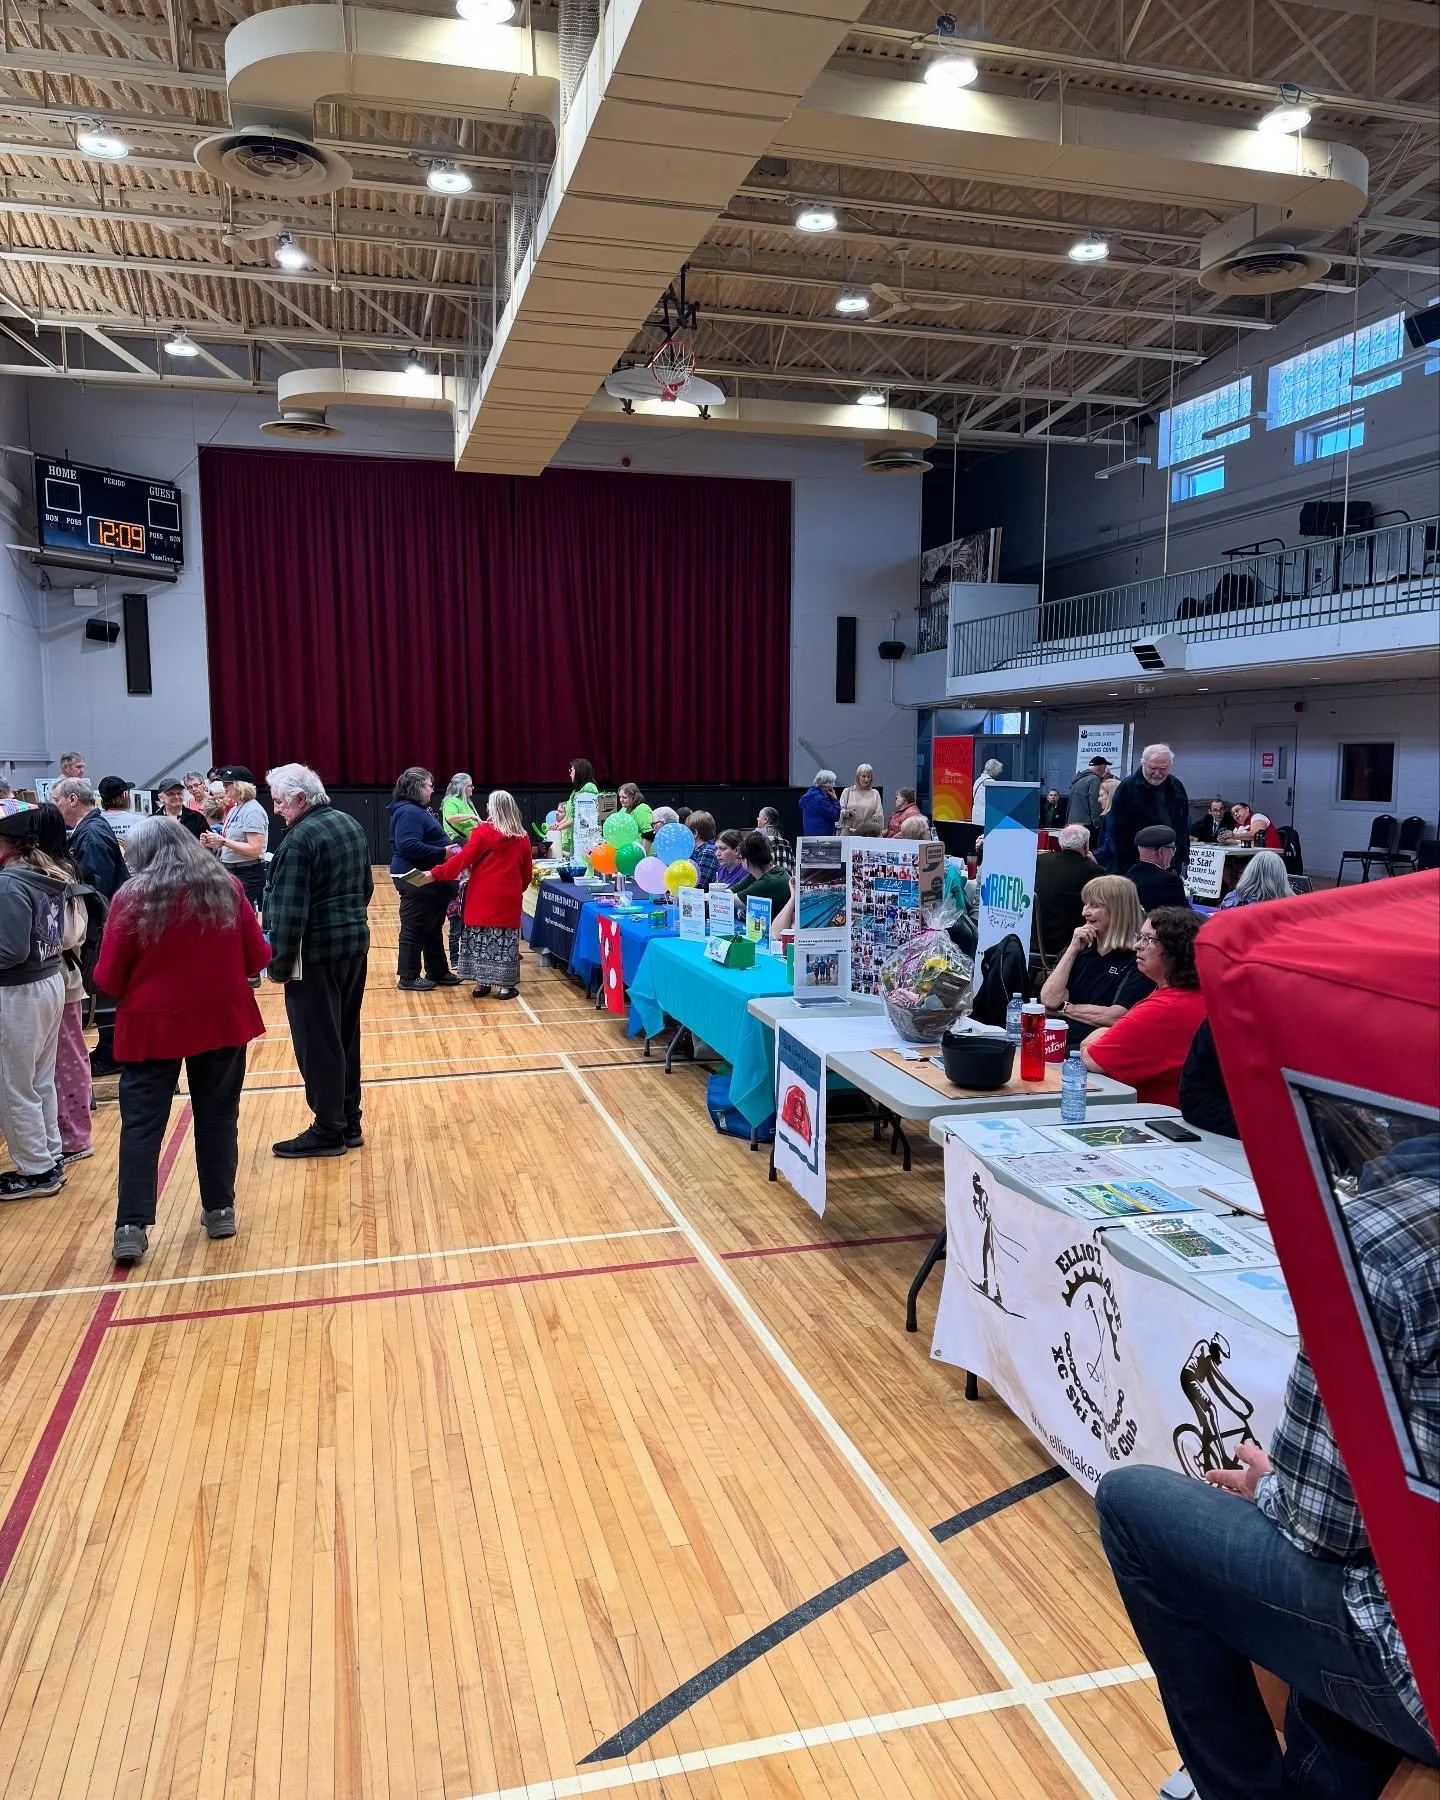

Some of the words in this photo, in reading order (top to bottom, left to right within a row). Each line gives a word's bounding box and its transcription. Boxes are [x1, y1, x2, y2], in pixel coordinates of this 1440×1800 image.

[48, 465, 77, 480] HOME
[103, 476, 126, 487] PERIOD
[149, 486, 176, 500] GUEST
[66, 518, 82, 526] POSS
[98, 520, 143, 551] 12:09
[149, 531, 164, 540] POSS
[1201, 850, 1216, 858] #324
[1196, 857, 1213, 867] Star
[882, 879, 903, 889] ELAC
[1102, 1277, 1123, 1332] AKE
[1051, 1345, 1069, 1380] XC
[1065, 1384, 1089, 1424] Ski
[1091, 1419, 1102, 1440] &
[1117, 1418, 1138, 1458] Club
